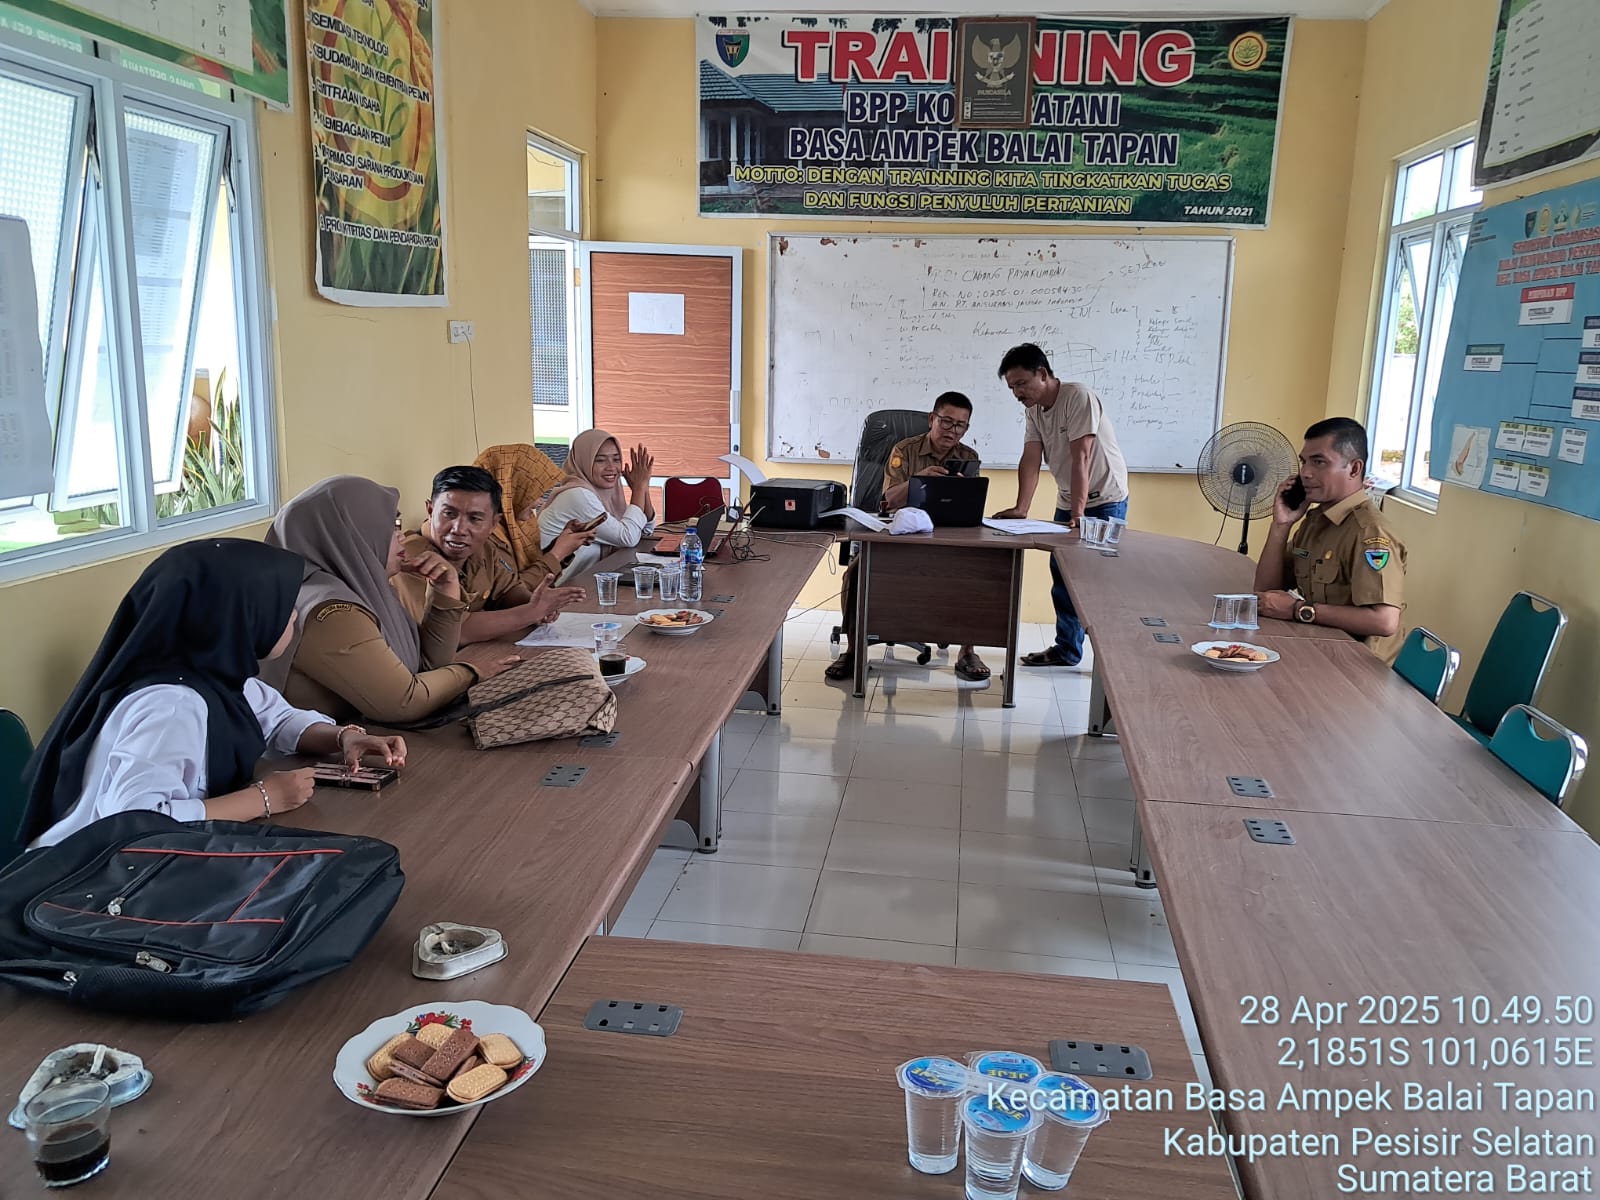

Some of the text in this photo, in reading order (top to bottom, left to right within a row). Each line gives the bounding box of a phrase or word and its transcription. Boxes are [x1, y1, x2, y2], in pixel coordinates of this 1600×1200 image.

[847, 91, 909, 123] BPP
[789, 127, 1180, 166] BASA AMPEK BALAI TAPAN
[734, 166, 1232, 191] MOTTO: DENGAN TRAINNING KITA TINGKATKAN TUGAS
[803, 191, 1133, 214] DAN FUNGSI PENYULUH PERTANIAN
[1183, 205, 1254, 218] TAHUN 2021
